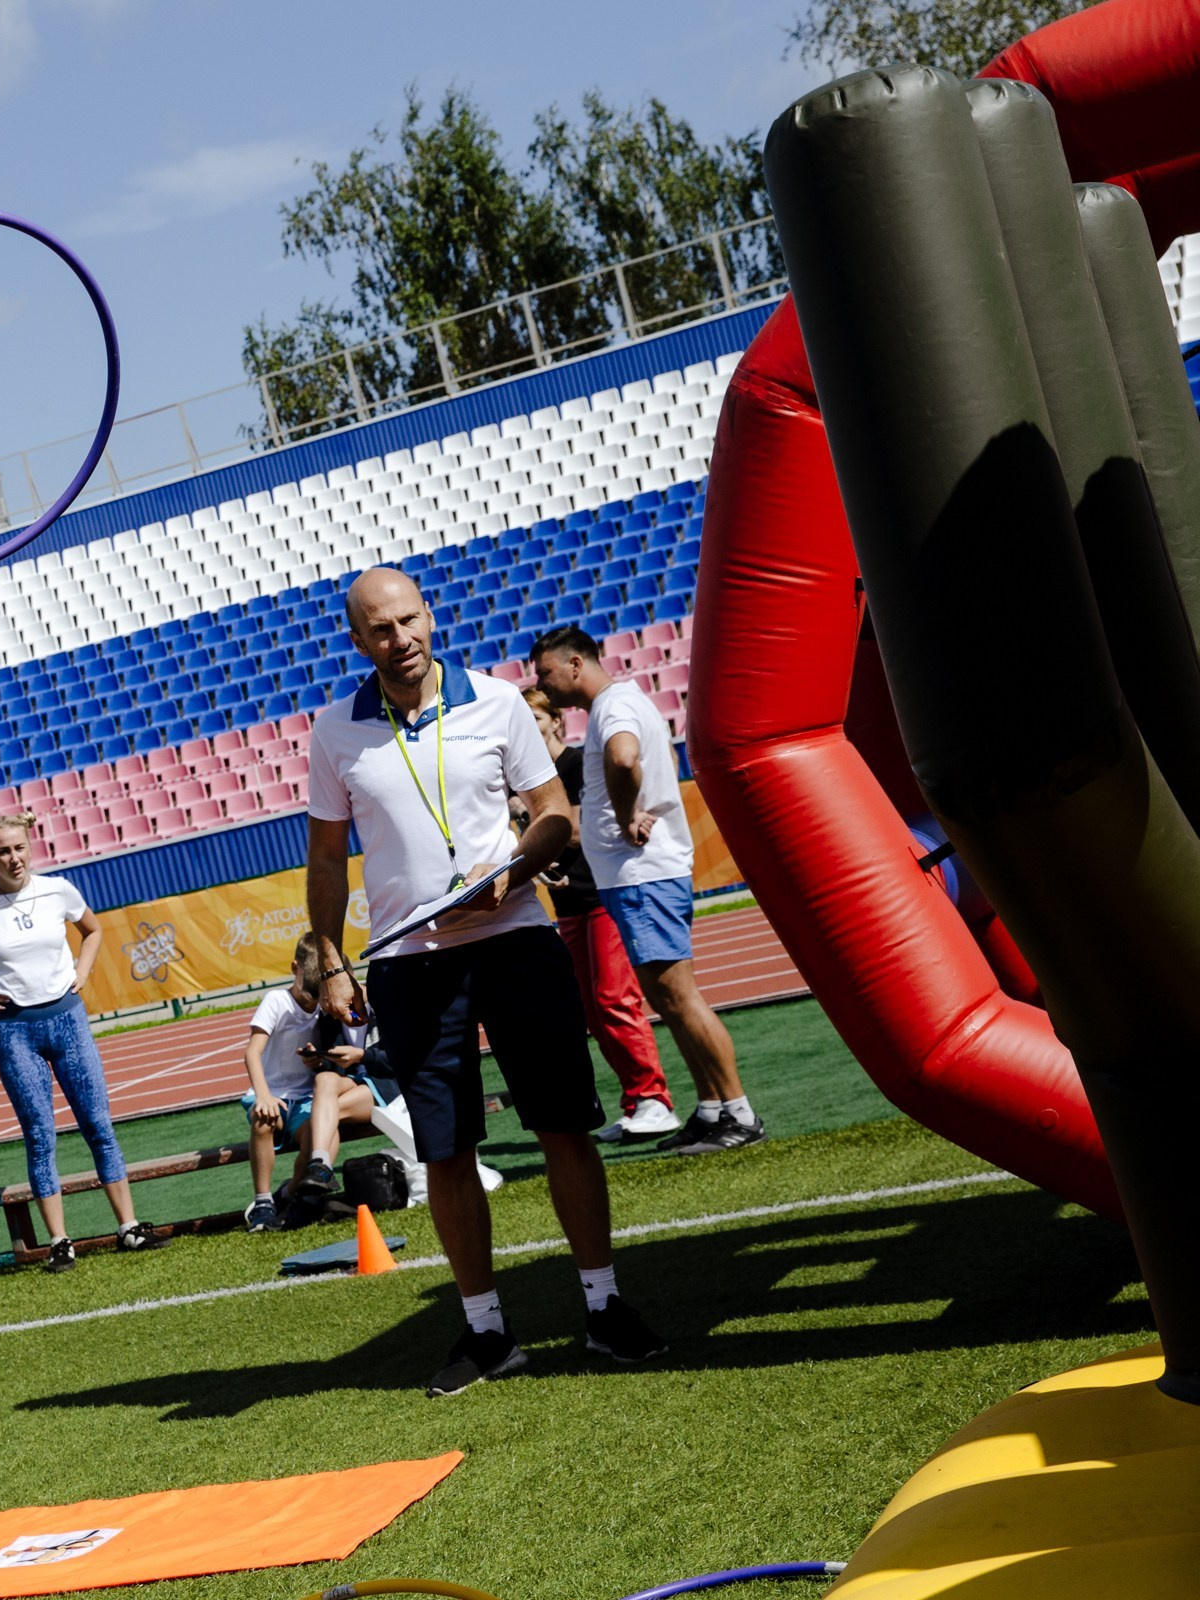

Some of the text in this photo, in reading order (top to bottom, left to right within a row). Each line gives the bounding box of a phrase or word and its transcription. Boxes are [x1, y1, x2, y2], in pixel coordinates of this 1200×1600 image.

[13, 914, 34, 931] 16
[262, 906, 305, 927] АТОМ
[258, 921, 311, 944] СПОРТ
[130, 930, 174, 963] АТОМ
[136, 944, 177, 974] ФЕСТ
